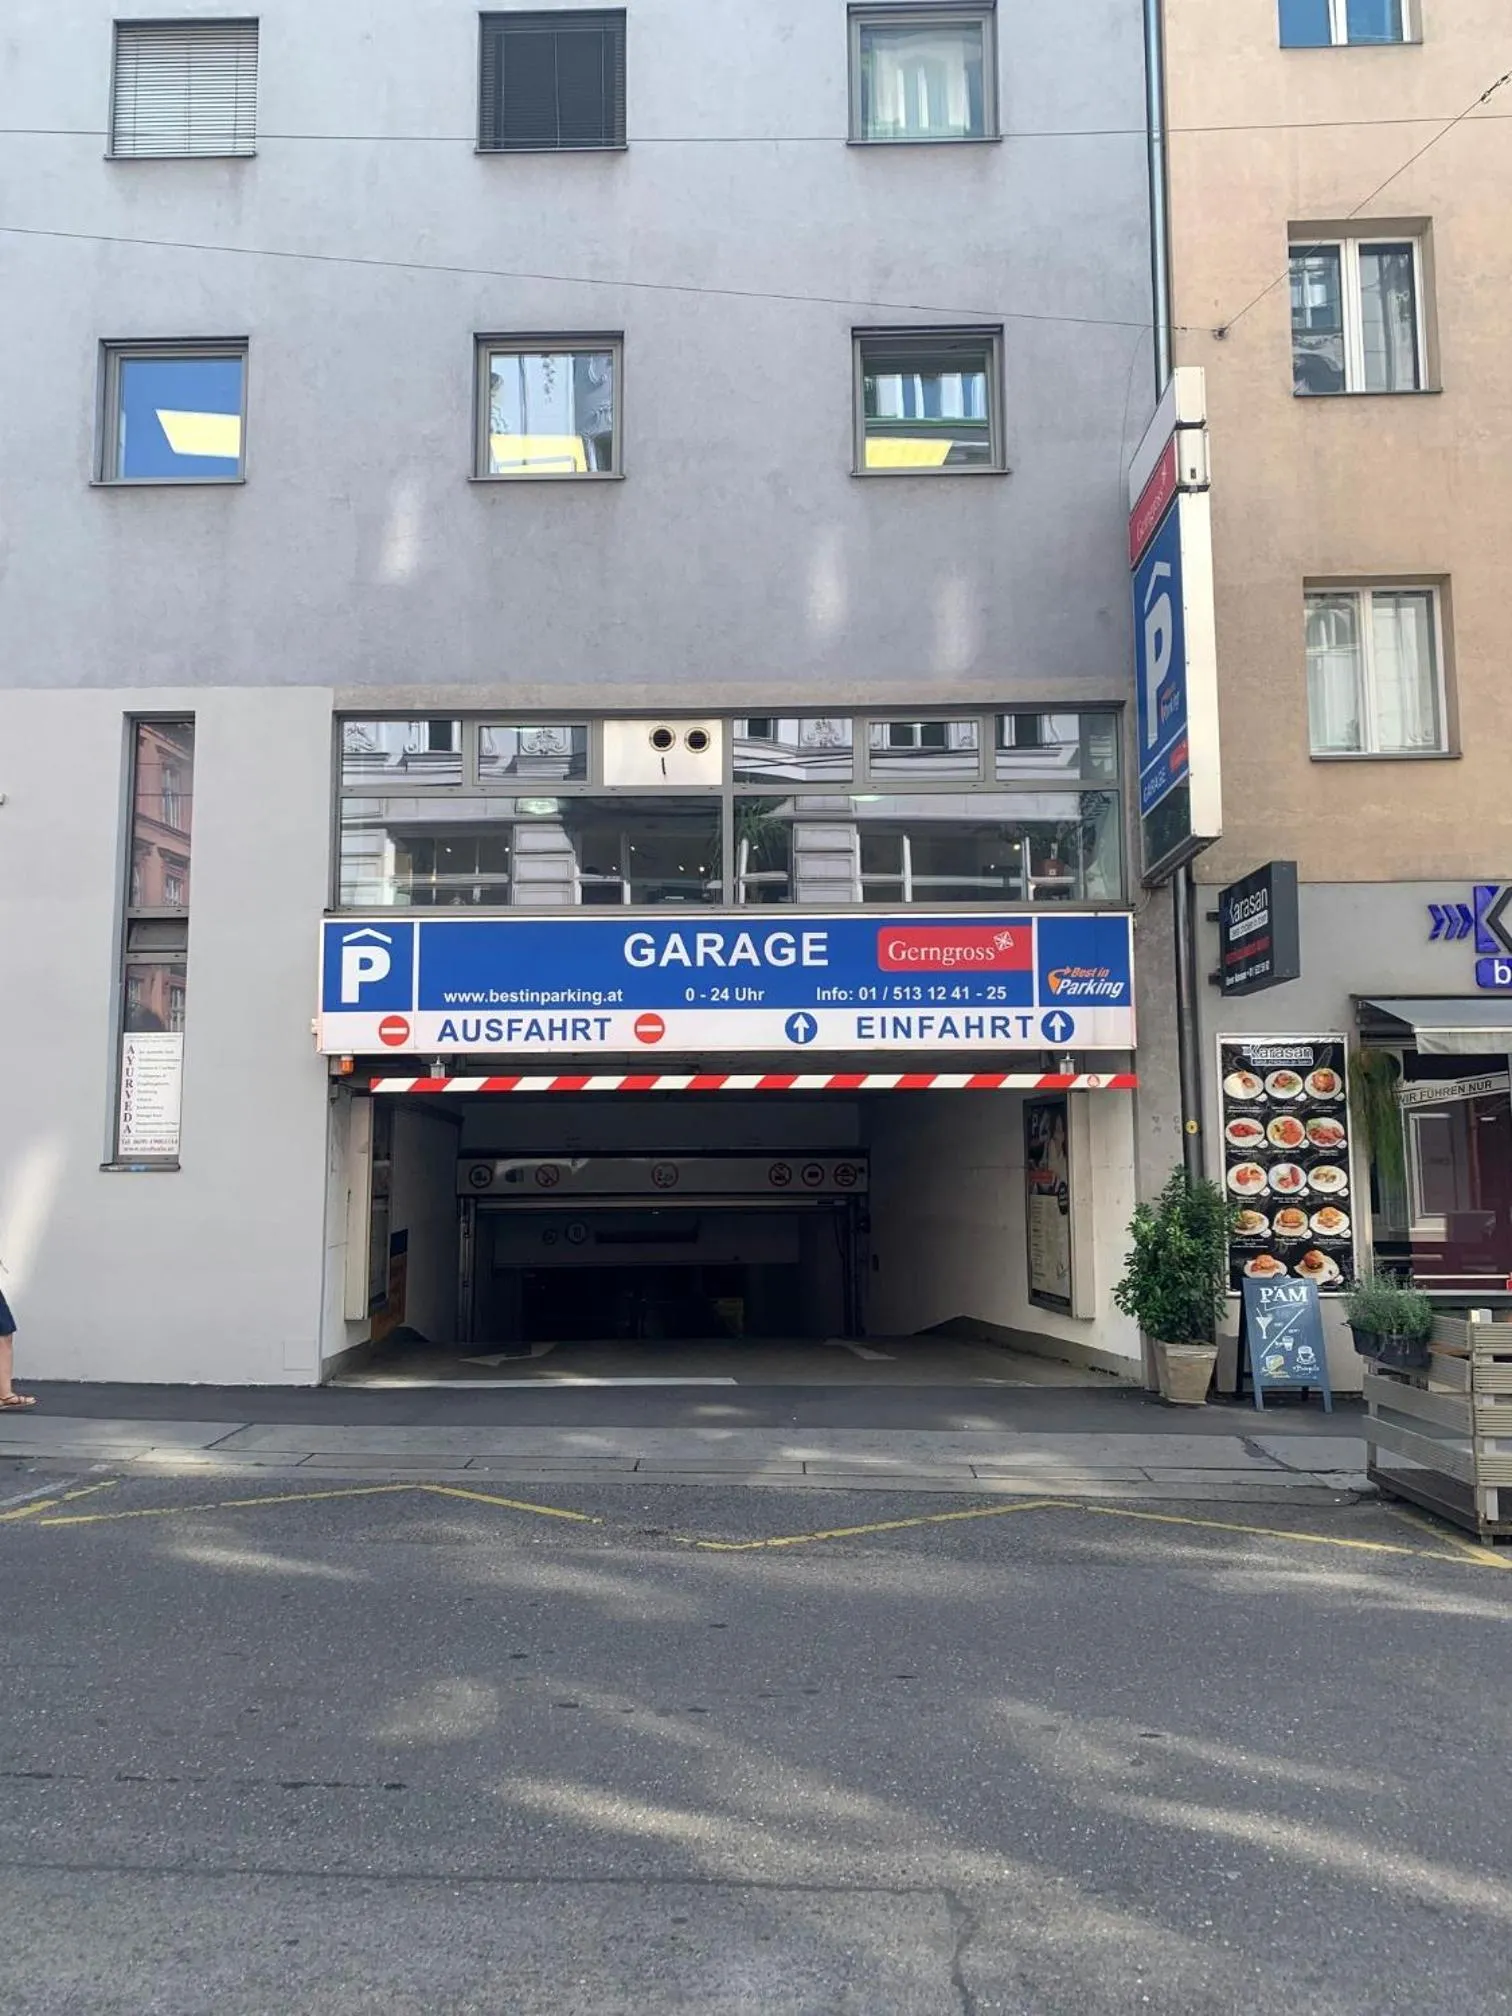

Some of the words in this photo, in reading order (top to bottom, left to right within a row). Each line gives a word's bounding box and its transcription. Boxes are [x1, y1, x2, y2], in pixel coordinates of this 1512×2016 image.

[1144, 591, 1173, 750] P
[623, 931, 829, 967] GARAGE
[888, 940, 995, 965] Gerngross
[341, 945, 391, 1004] P
[1070, 966, 1097, 978] Best
[1097, 966, 1110, 977] in
[444, 987, 623, 1005] www.bestinparking.at
[685, 988, 695, 1002] 0
[710, 988, 730, 1002] 24
[735, 987, 765, 1001] Uhr
[816, 986, 854, 1001] Info:
[859, 986, 878, 1001] 01
[892, 986, 922, 1001] 513
[927, 986, 946, 1000] 12
[950, 986, 970, 1000] 41
[986, 986, 1007, 1000] 25
[1056, 978, 1124, 998] Parking
[437, 1018, 611, 1042] AUSFAHRT
[857, 1015, 1034, 1039] EINFAHRT
[1469, 1079, 1492, 1092] NUR
